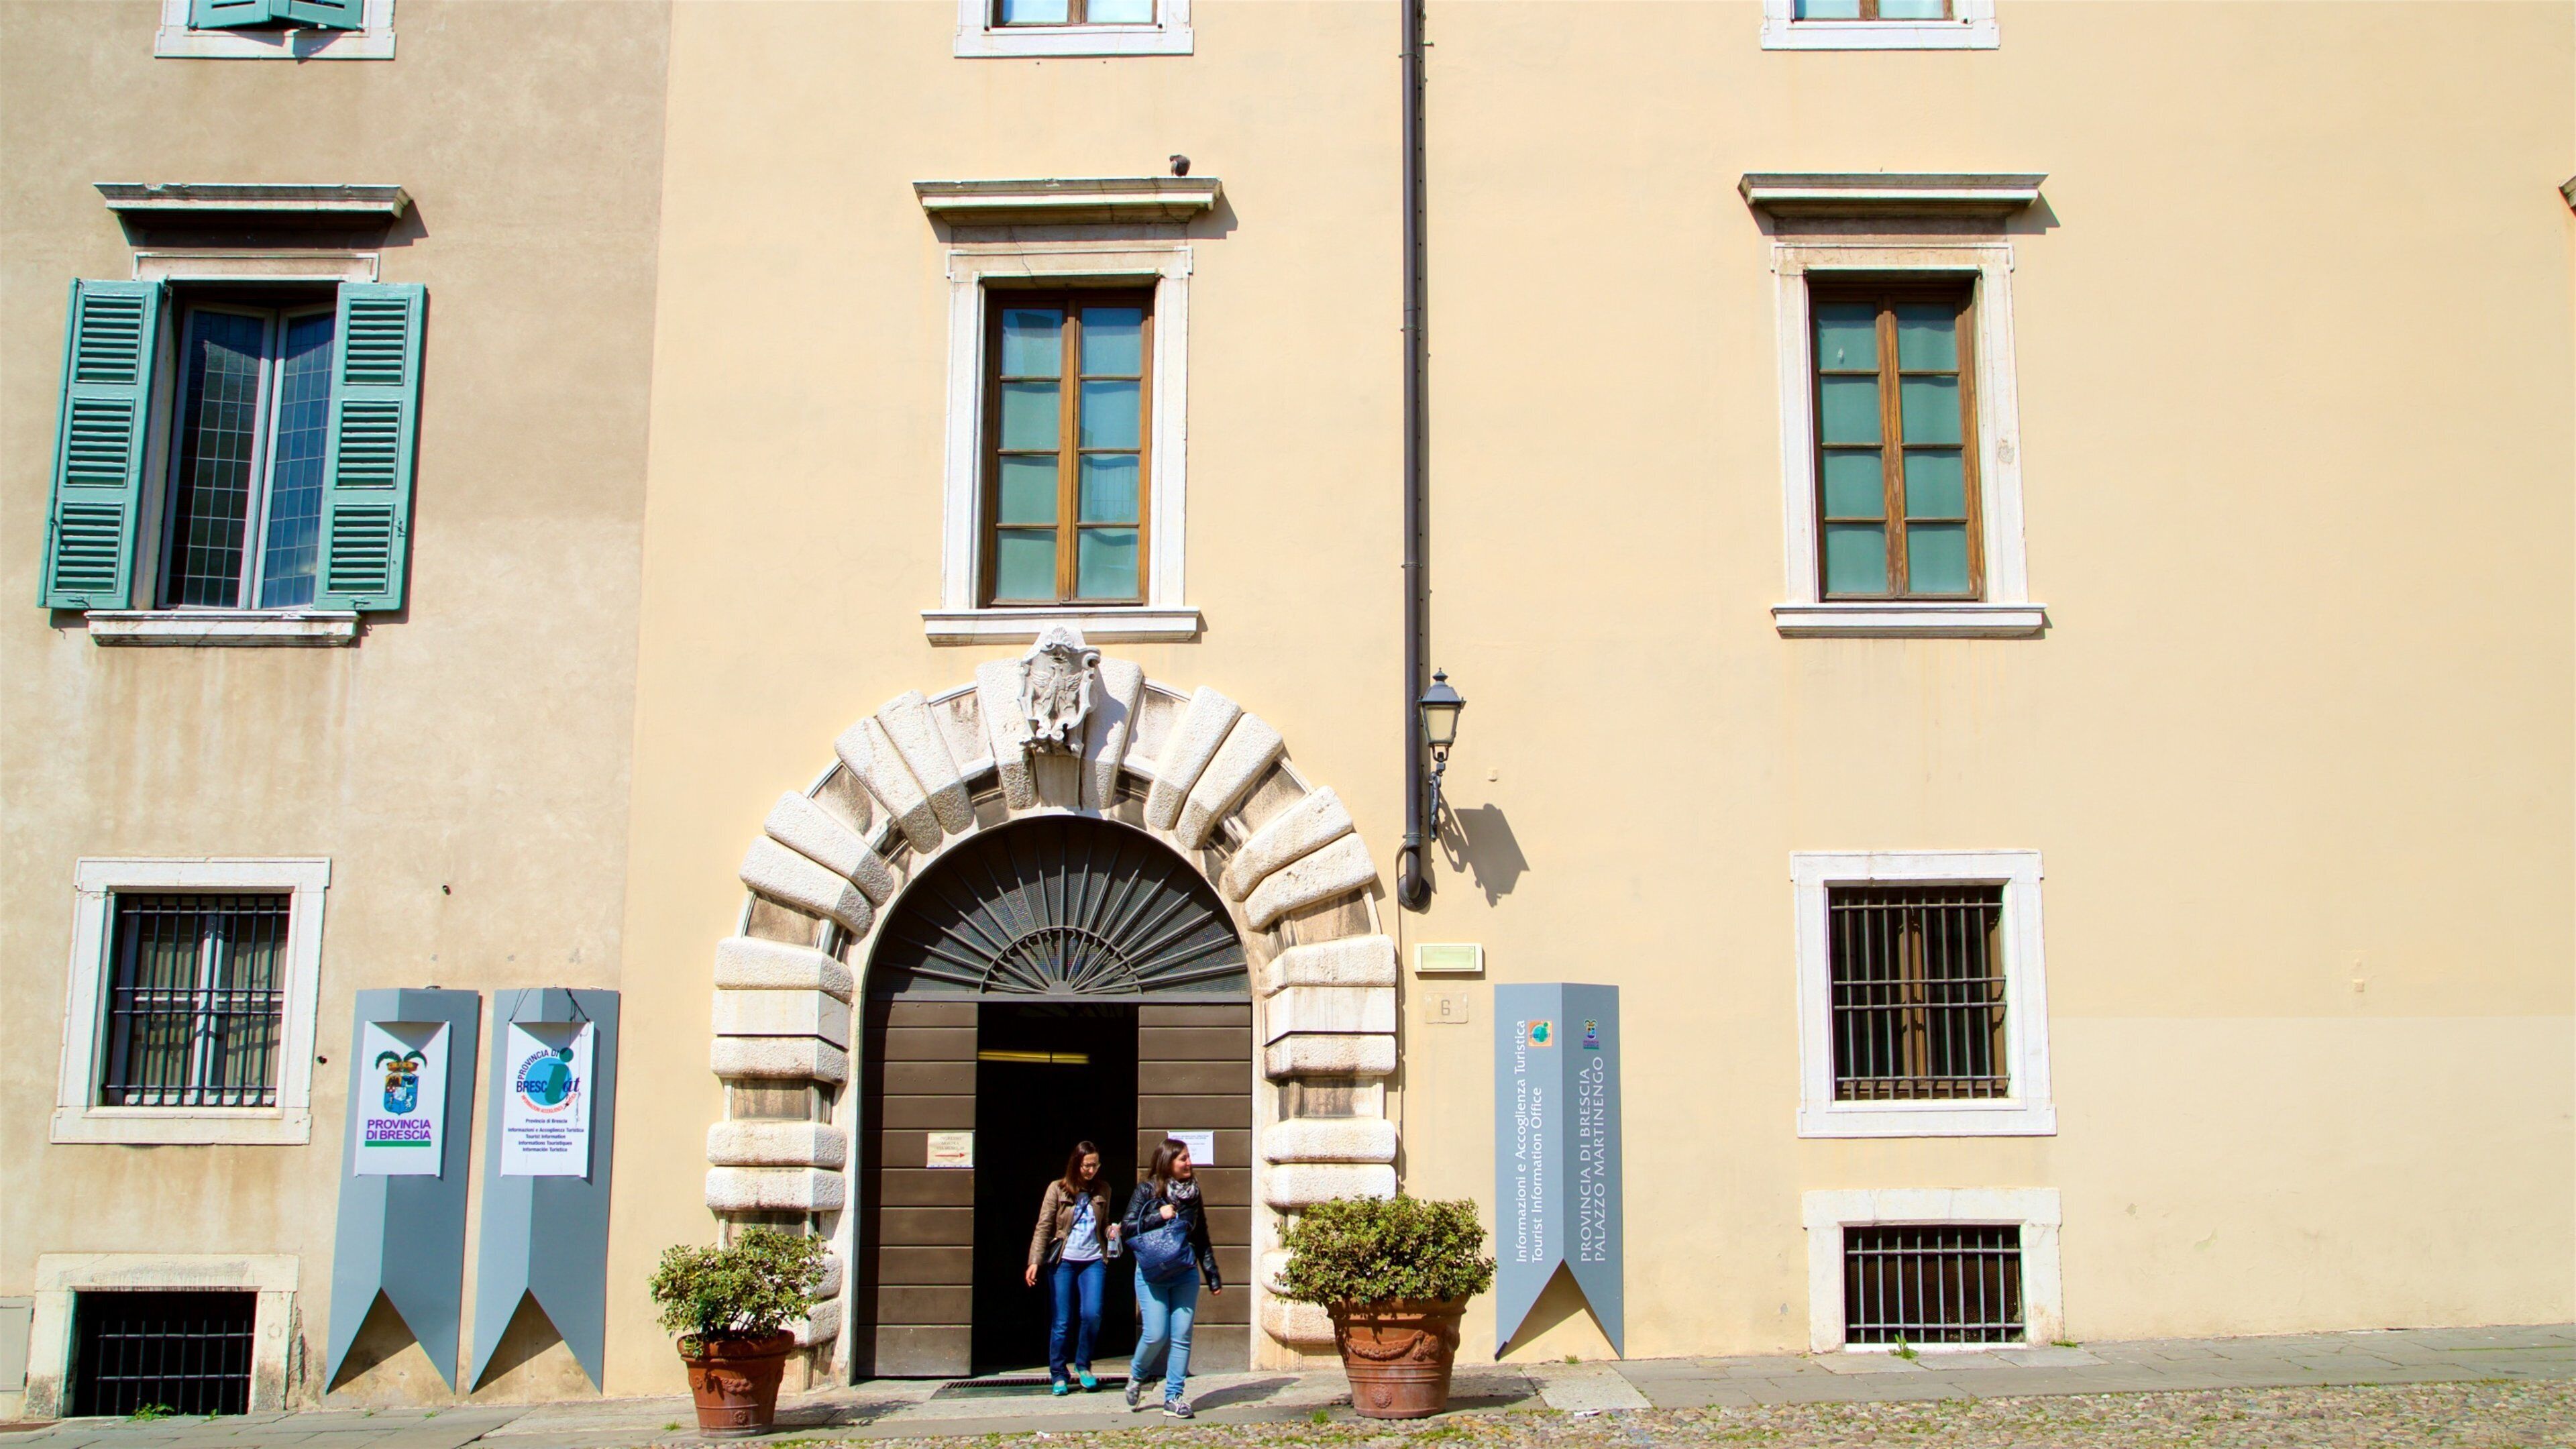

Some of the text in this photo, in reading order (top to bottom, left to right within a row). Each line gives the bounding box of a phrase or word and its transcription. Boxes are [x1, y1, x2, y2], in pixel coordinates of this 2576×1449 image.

[1441, 1000, 1450, 1016] 6
[517, 1049, 559, 1080] PROVINCIA DI
[366, 1130, 431, 1140] DI BRESCIA
[367, 1119, 431, 1130] PROVINCIA
[1514, 1020, 1529, 1263] Informazioni e Accoglienza Turistica
[1530, 1087, 1543, 1263] Tourist Information Office
[1579, 1068, 1592, 1262] PROVINCIA DI BRESCIA
[1593, 1057, 1605, 1262] PALAZZO MARTINENGO
